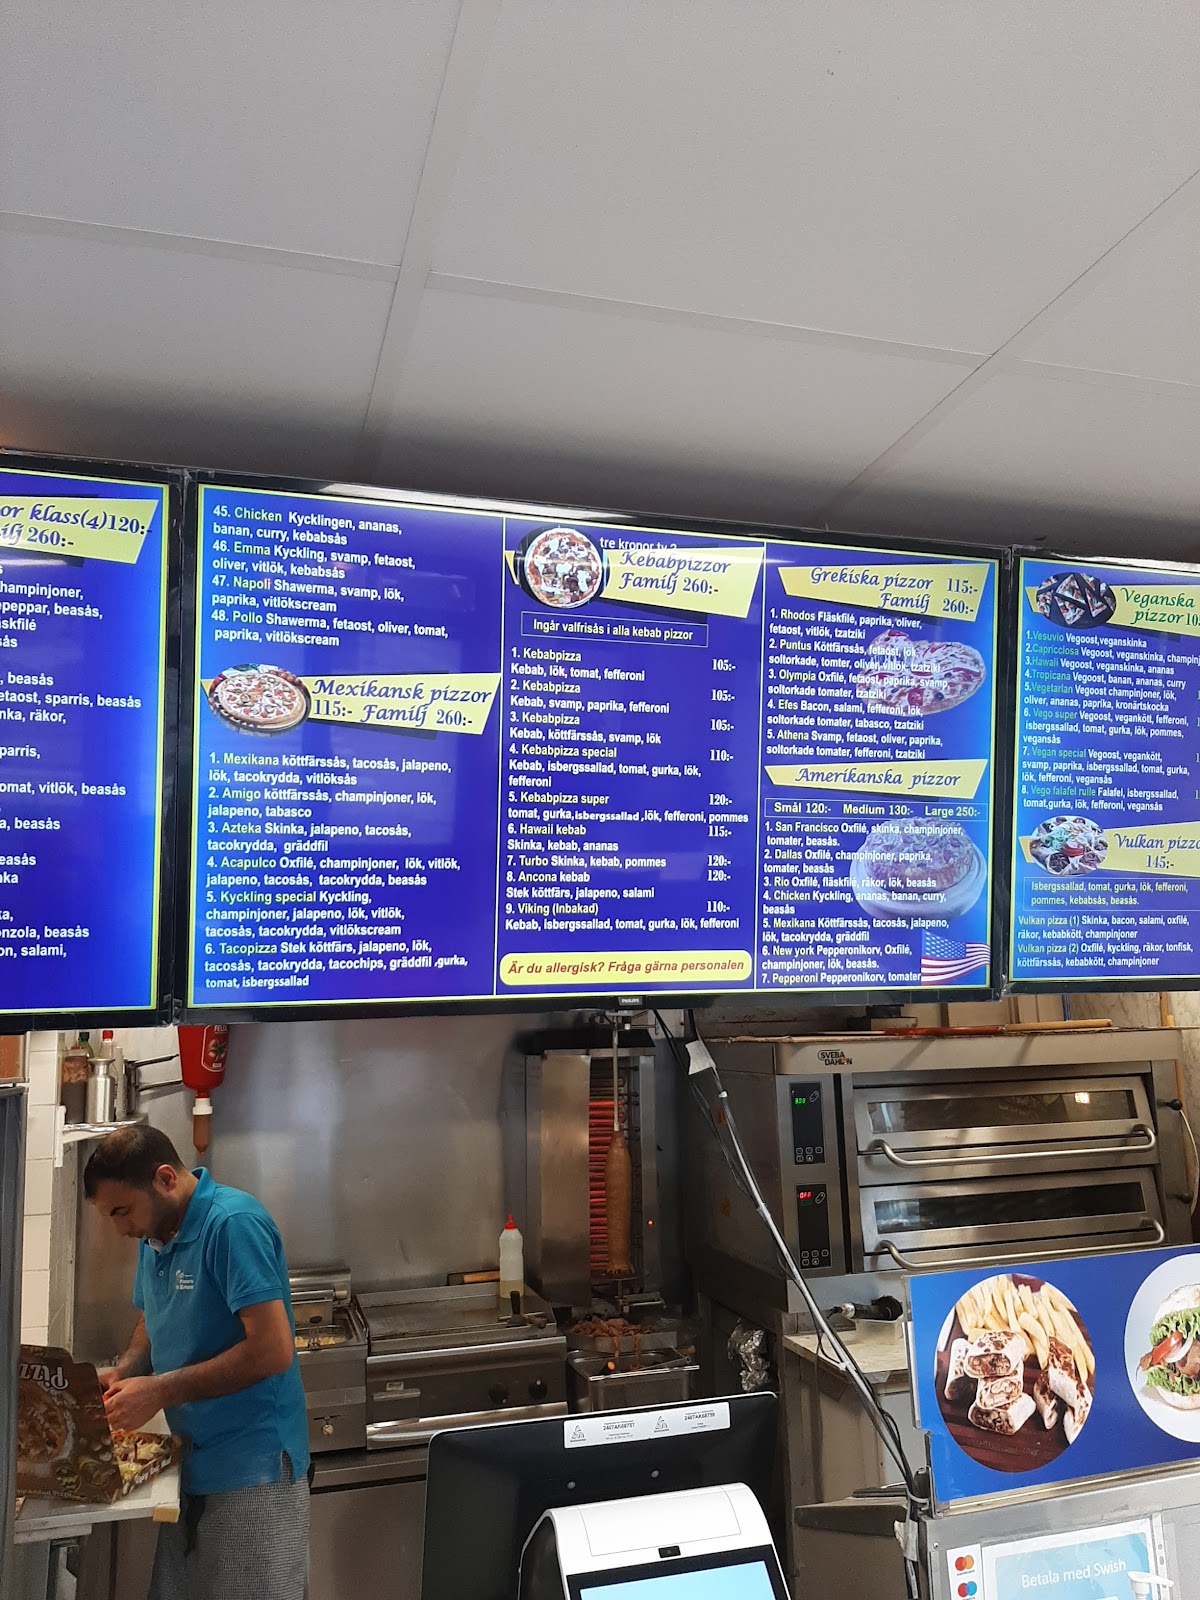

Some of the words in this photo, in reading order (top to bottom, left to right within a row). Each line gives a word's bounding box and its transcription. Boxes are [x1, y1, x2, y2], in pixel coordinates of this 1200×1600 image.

[213, 504, 231, 517] 45.
[234, 506, 282, 522] Chicken
[288, 511, 355, 531] Kycklingen,
[358, 520, 402, 535] ananas,
[27, 527, 74, 547] 260:-
[213, 522, 253, 538] banan,
[256, 528, 289, 542] curry,
[292, 528, 347, 545] kebabsås
[600, 537, 615, 549] tre
[619, 552, 731, 574] Kebabpizzor
[211, 574, 229, 586] 47.
[233, 575, 271, 591] Napoli
[273, 578, 337, 597] Shawerma,
[340, 586, 381, 600] svamp,
[383, 587, 404, 602] lök,
[618, 572, 678, 595] Familj
[683, 577, 719, 595] 260:-
[810, 567, 880, 585] Grekiska
[880, 573, 934, 591] pizzor
[946, 578, 978, 595] 115:-
[878, 593, 931, 612] Familj
[942, 598, 974, 614] 260:-
[1120, 587, 1195, 608] Veganska
[211, 609, 229, 621] 48.
[232, 610, 263, 624] Pollo
[265, 613, 330, 630] Shawerma,
[332, 617, 374, 633] fetaost,
[377, 621, 411, 636] oliver,
[413, 623, 448, 638] tomat,
[770, 607, 778, 619] 1.
[780, 608, 815, 621] Rhodos
[817, 610, 857, 625] Fläskfilé,
[859, 615, 894, 627] paprika,
[896, 619, 922, 629] oliver,
[1130, 608, 1184, 624] pizzor
[533, 618, 560, 633] Ingår
[562, 621, 604, 634] valfrisås
[606, 623, 610, 634] i
[612, 624, 630, 636] alla
[632, 625, 662, 638] kebab
[663, 628, 693, 641] pizzor
[769, 623, 803, 637] fetaost,
[805, 625, 832, 639] vitlök,
[834, 627, 865, 639] tzatziki
[511, 646, 520, 658] 1.
[523, 647, 581, 663] Kebabpizza
[510, 662, 547, 677] Kebab,
[549, 664, 567, 678] lök,
[569, 666, 601, 680] tomat,
[603, 667, 645, 681] fefferoni
[712, 658, 736, 671] 105:-
[0, 690, 41, 705] etaost,
[44, 693, 93, 707] sparris,
[97, 694, 141, 708] beasås
[312, 679, 425, 700] Mexikansk
[425, 688, 491, 707] pizzor
[29, 708, 66, 724] räkor,
[314, 700, 353, 717] 115:-
[360, 703, 429, 727] Familj
[436, 708, 473, 727] 260:-
[508, 742, 518, 754] 4.
[521, 743, 579, 758] Kebabpizza
[581, 746, 617, 759] special
[710, 749, 734, 761] 110:-
[209, 751, 220, 764] 1.
[223, 752, 279, 766] Mexikana
[282, 754, 349, 770] köttfärssås,
[352, 757, 399, 771] tacosås,
[401, 758, 451, 773] jalapeno,
[1021, 760, 1051, 771] svamp,
[1052, 760, 1084, 772] paprika,
[1086, 761, 1139, 774] isbergssallad,
[1140, 764, 1164, 775] tomat,
[1166, 764, 1190, 776] gurka,
[795, 767, 903, 785] Amerikanska
[908, 770, 961, 789] pizzor
[0, 781, 35, 795] omat,
[38, 781, 77, 796] vitlök,
[81, 782, 126, 795] beasås
[208, 786, 219, 798] 2.
[222, 787, 261, 802] Amigo
[263, 787, 332, 803] köttfärssås,
[334, 789, 414, 805] champinjoner,
[416, 791, 436, 805] lök,
[774, 801, 801, 813] Smål
[806, 802, 831, 814] 120:-
[843, 803, 885, 815] Medium
[889, 804, 914, 815] 130:-
[925, 805, 954, 818] Large
[955, 806, 980, 817] 250:-
[507, 822, 517, 834] 6.
[519, 823, 553, 834] Hawaii
[555, 823, 586, 835] kebab
[1114, 833, 1164, 848] Vulkan
[206, 855, 217, 867] 4.
[220, 856, 276, 870] Acapulco
[279, 856, 316, 870] Oxfilé,
[319, 856, 399, 871] champinjoner,
[405, 857, 425, 870] lök,
[427, 857, 460, 870] vitlök,
[506, 854, 516, 866] 7.
[518, 854, 549, 866] Turbo
[550, 854, 587, 868] Skinka,
[589, 855, 622, 868] kebab,
[624, 858, 666, 869] pommes
[707, 854, 731, 866] 120:-
[1146, 855, 1174, 869] 145:-
[206, 890, 217, 902] 5.
[220, 890, 272, 905] Kyckling
[275, 890, 316, 905] special
[319, 890, 372, 905] Kyckling,
[505, 902, 515, 914] 9.
[517, 902, 549, 916] Viking
[552, 902, 598, 916] (Inbakad)
[706, 900, 730, 912] 110:-
[762, 917, 771, 928] 5.
[773, 917, 815, 928] Mexikana
[817, 917, 870, 929] Köttfärssås,
[872, 916, 909, 929] tacosås,
[909, 917, 949, 930] jalapeno,
[1018, 915, 1045, 925] Vulkan
[1047, 915, 1068, 927] pizza
[1069, 915, 1080, 927] (1)
[1081, 915, 1110, 926] Skinka,
[1111, 915, 1137, 926] bacon,
[1138, 915, 1165, 926] salami,
[1166, 914, 1189, 926] oxfilé,
[20, 943, 67, 958] salami,
[761, 945, 770, 956] 6.
[772, 945, 792, 956] New
[794, 945, 814, 958] york
[816, 944, 882, 958] Pepperonikorv,
[884, 943, 912, 955] Oxfilé,
[508, 962, 525, 974] Är
[526, 962, 543, 974] du
[545, 961, 605, 976] allergisk?
[608, 960, 642, 975] Fråga
[645, 961, 678, 975] gärna
[681, 960, 744, 974] personalen
[820, 1051, 845, 1060] SVEBA
[1021, 1571, 1060, 1589] Betala
[1063, 1565, 1091, 1582] med
[1094, 1559, 1127, 1578] Swish
